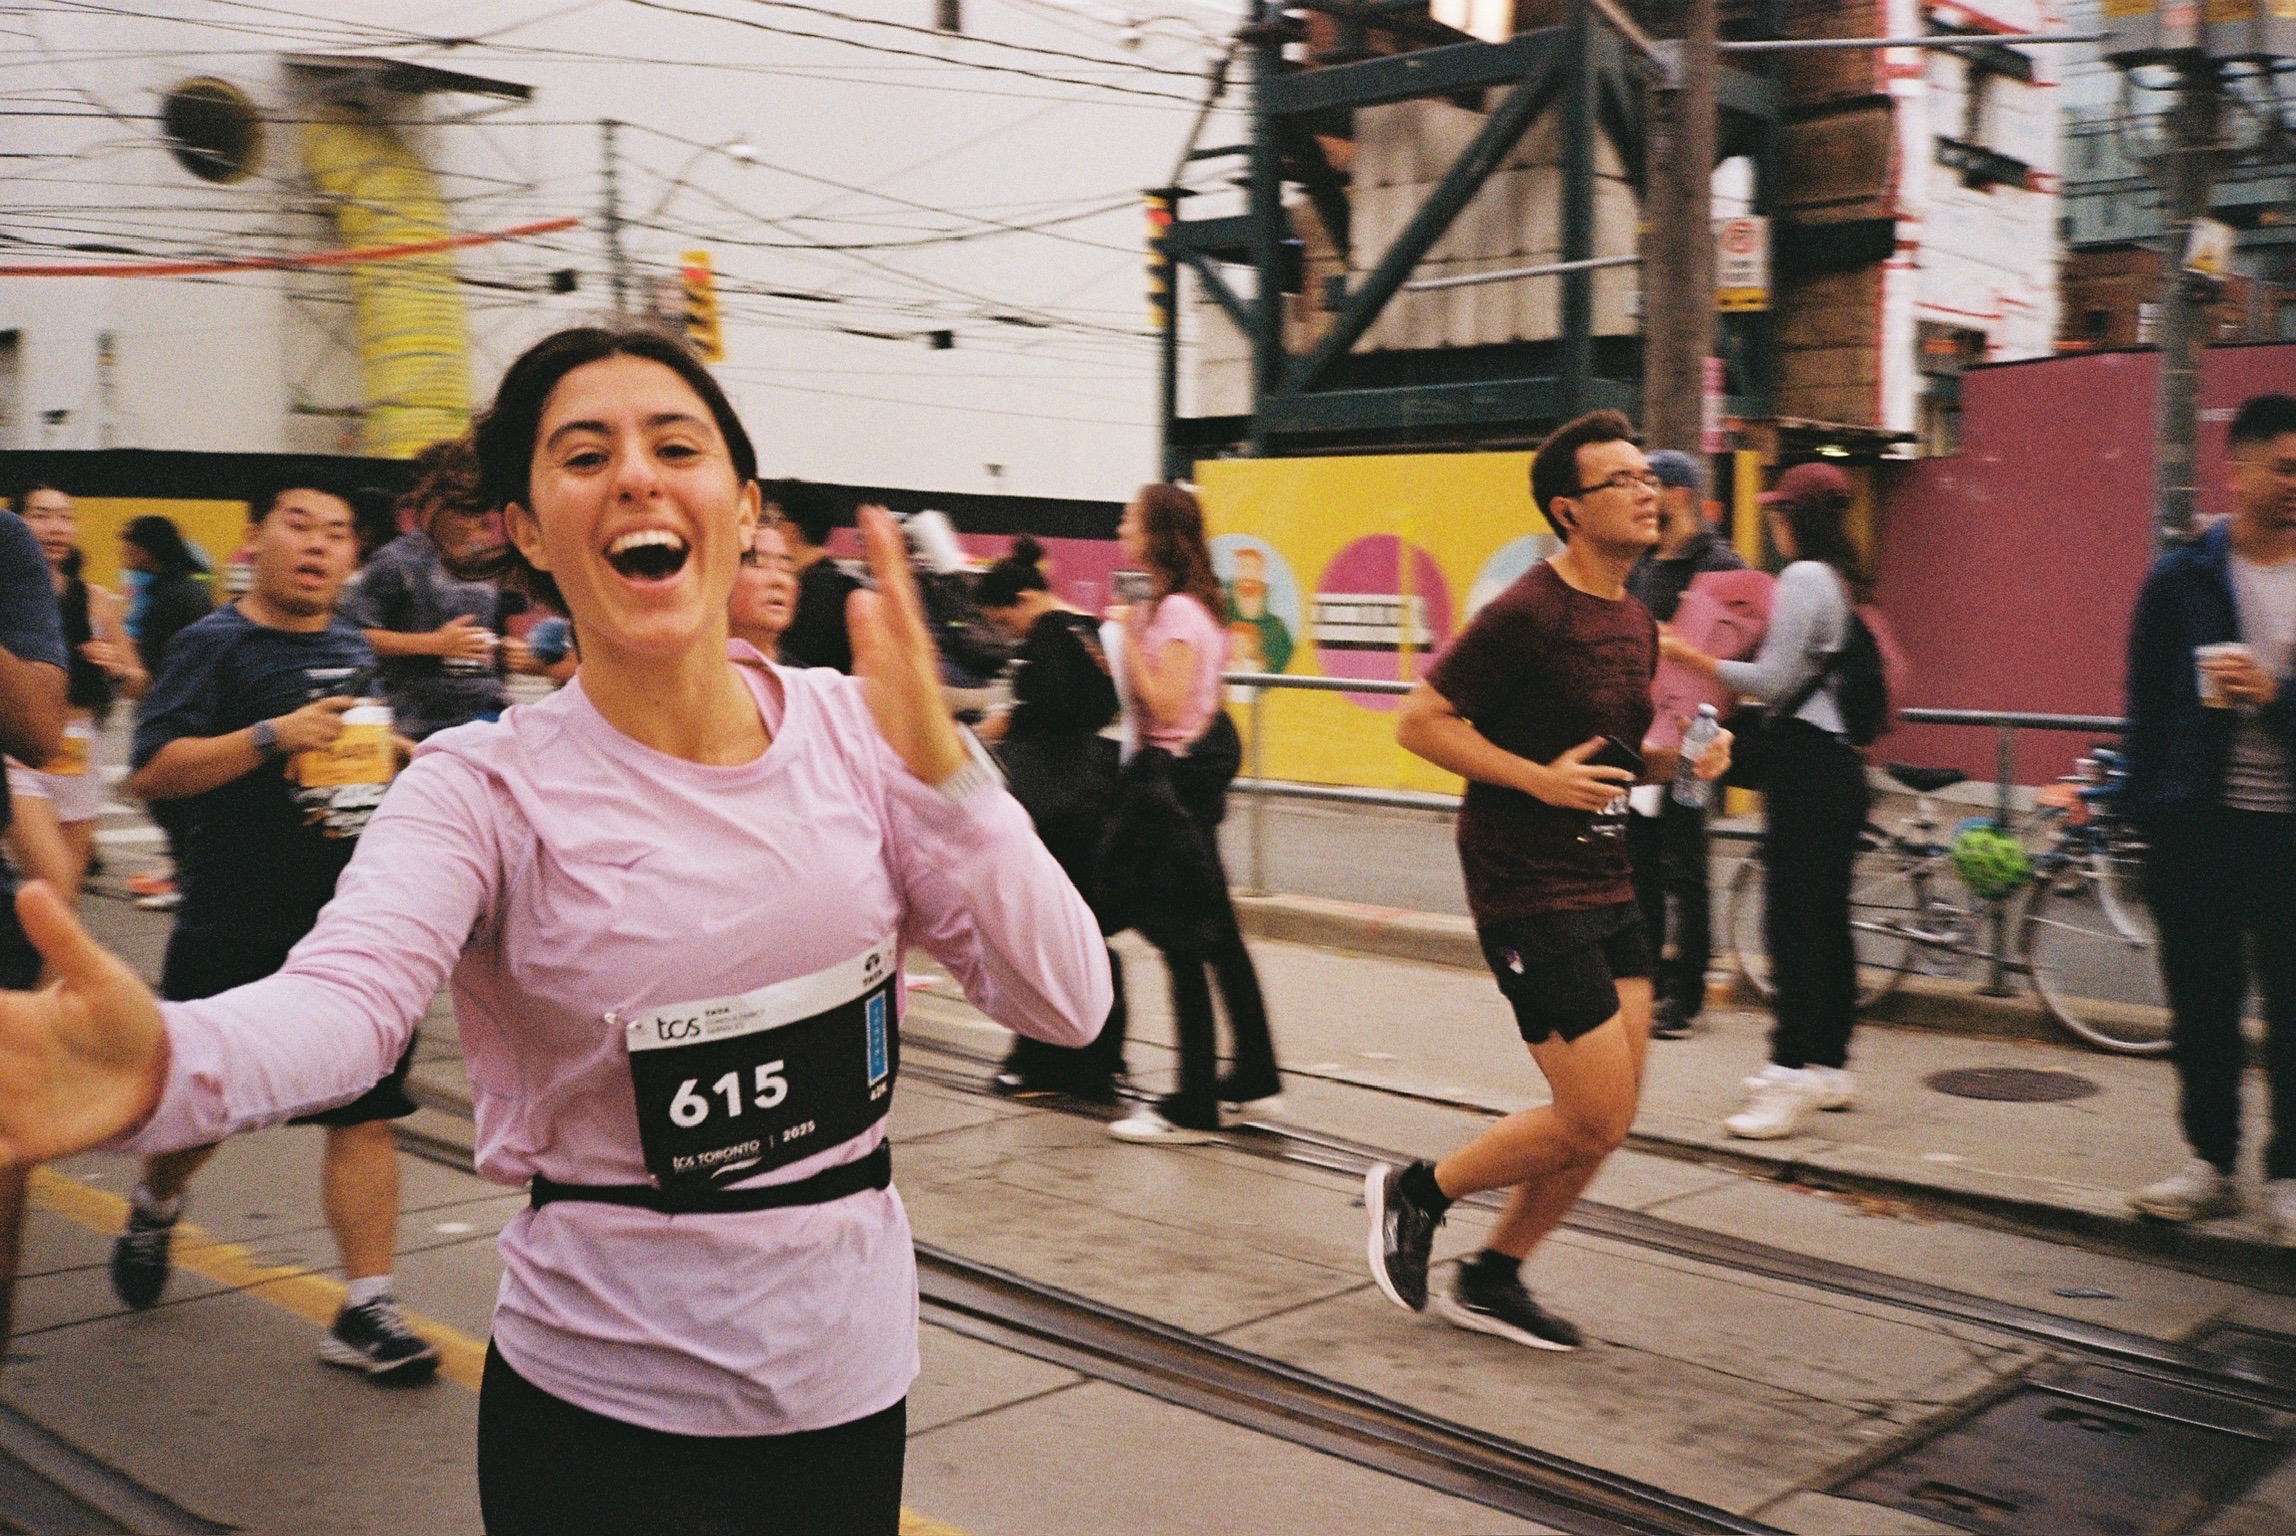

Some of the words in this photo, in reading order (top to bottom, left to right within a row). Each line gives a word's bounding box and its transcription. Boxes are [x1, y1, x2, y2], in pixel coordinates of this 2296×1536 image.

[656, 1016, 701, 1041] tcs
[669, 1059, 788, 1128] 615
[698, 1139, 760, 1165] TORONTO
[782, 1119, 816, 1143] 2025
